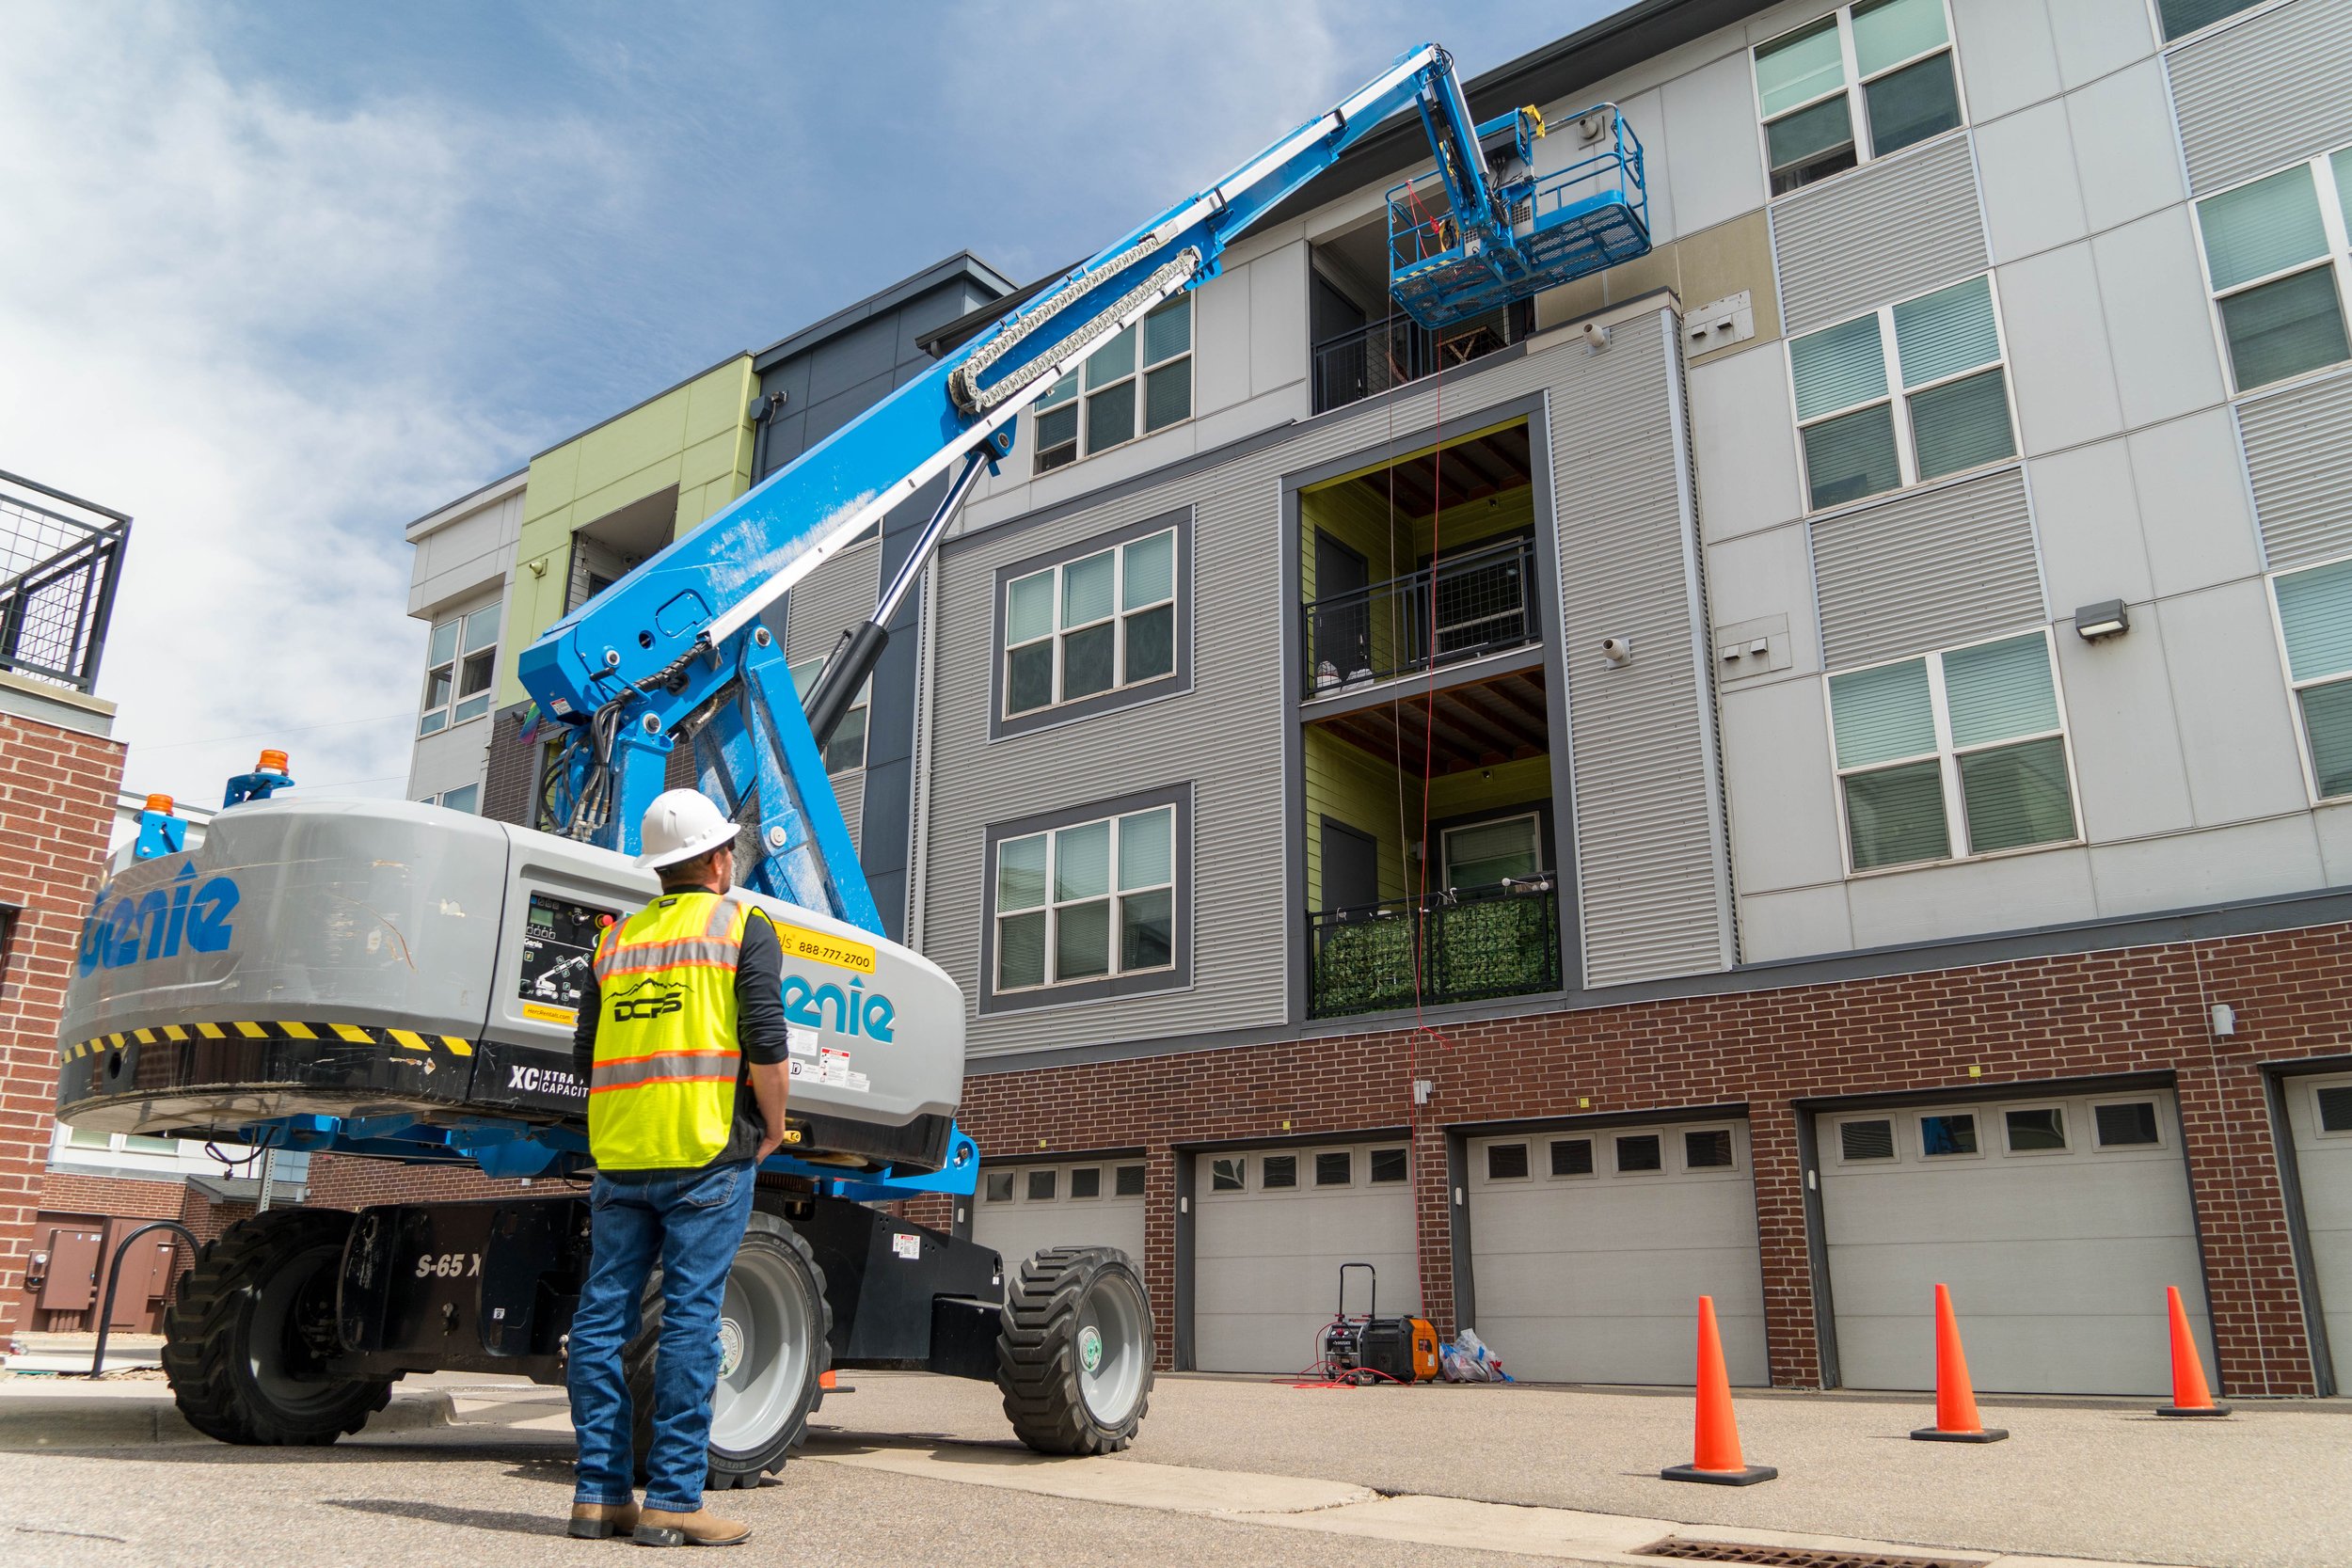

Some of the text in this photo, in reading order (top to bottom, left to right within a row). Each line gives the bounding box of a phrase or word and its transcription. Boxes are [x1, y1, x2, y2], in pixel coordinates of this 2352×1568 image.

[799, 942, 870, 968] 888-777-2700
[527, 1007, 571, 1021] HercRentals.com
[782, 974, 896, 1045] enie
[508, 1065, 540, 1091] XC
[543, 1070, 574, 1085] XTRA
[541, 1082, 590, 1099] CAPACIT
[415, 1254, 466, 1278] S-65
